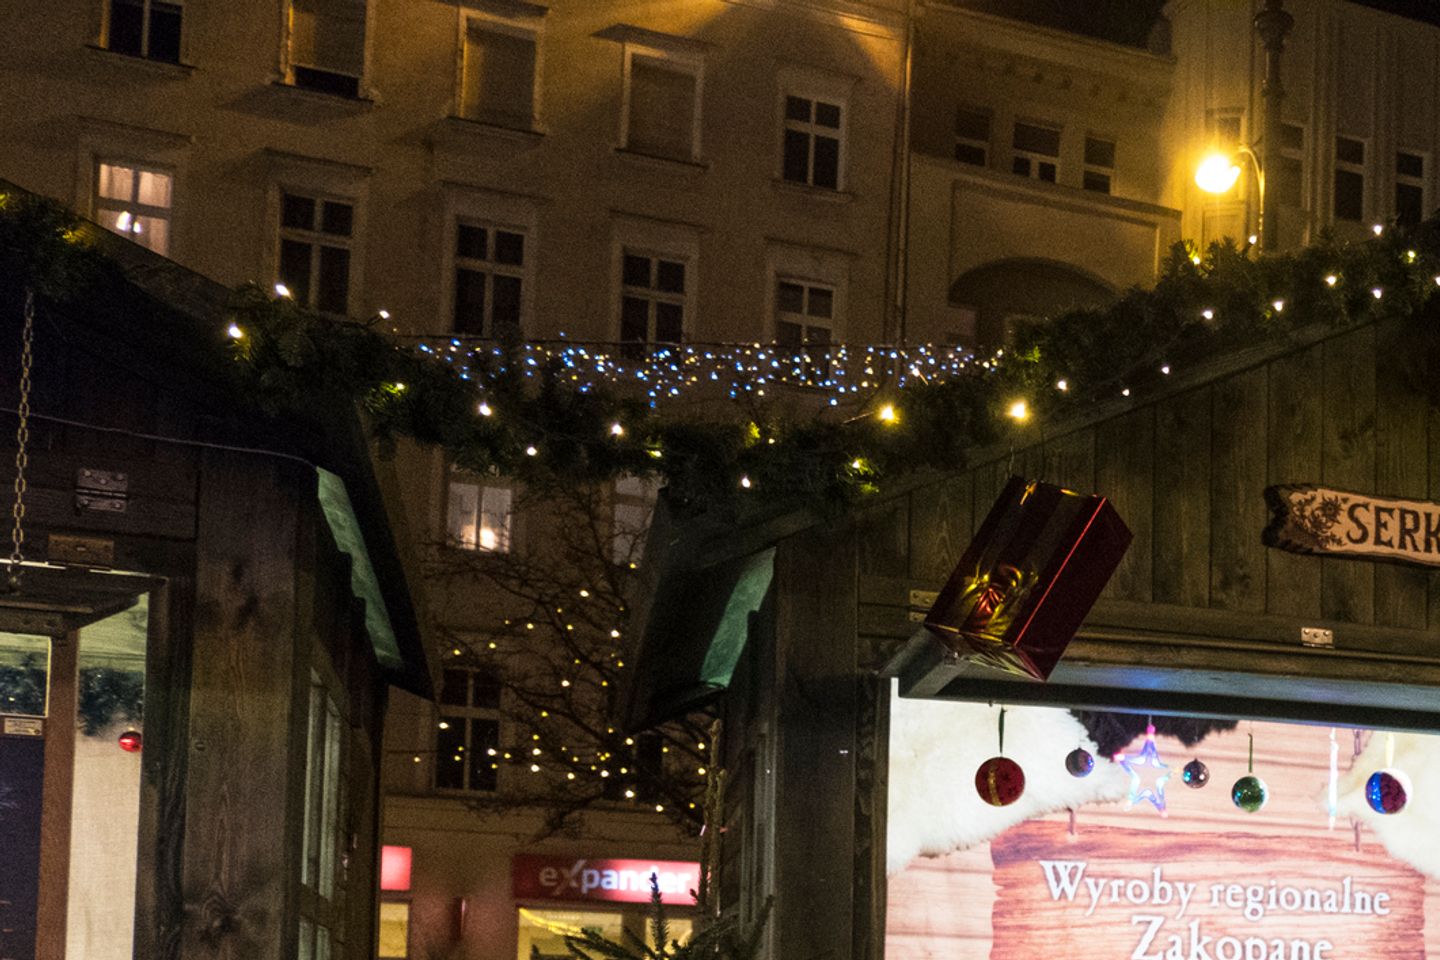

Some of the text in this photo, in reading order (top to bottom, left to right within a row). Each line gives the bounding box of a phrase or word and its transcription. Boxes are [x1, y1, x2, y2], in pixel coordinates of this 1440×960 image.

[538, 859, 692, 895] expander
[1039, 859, 1391, 922] Wyroby regionalne
